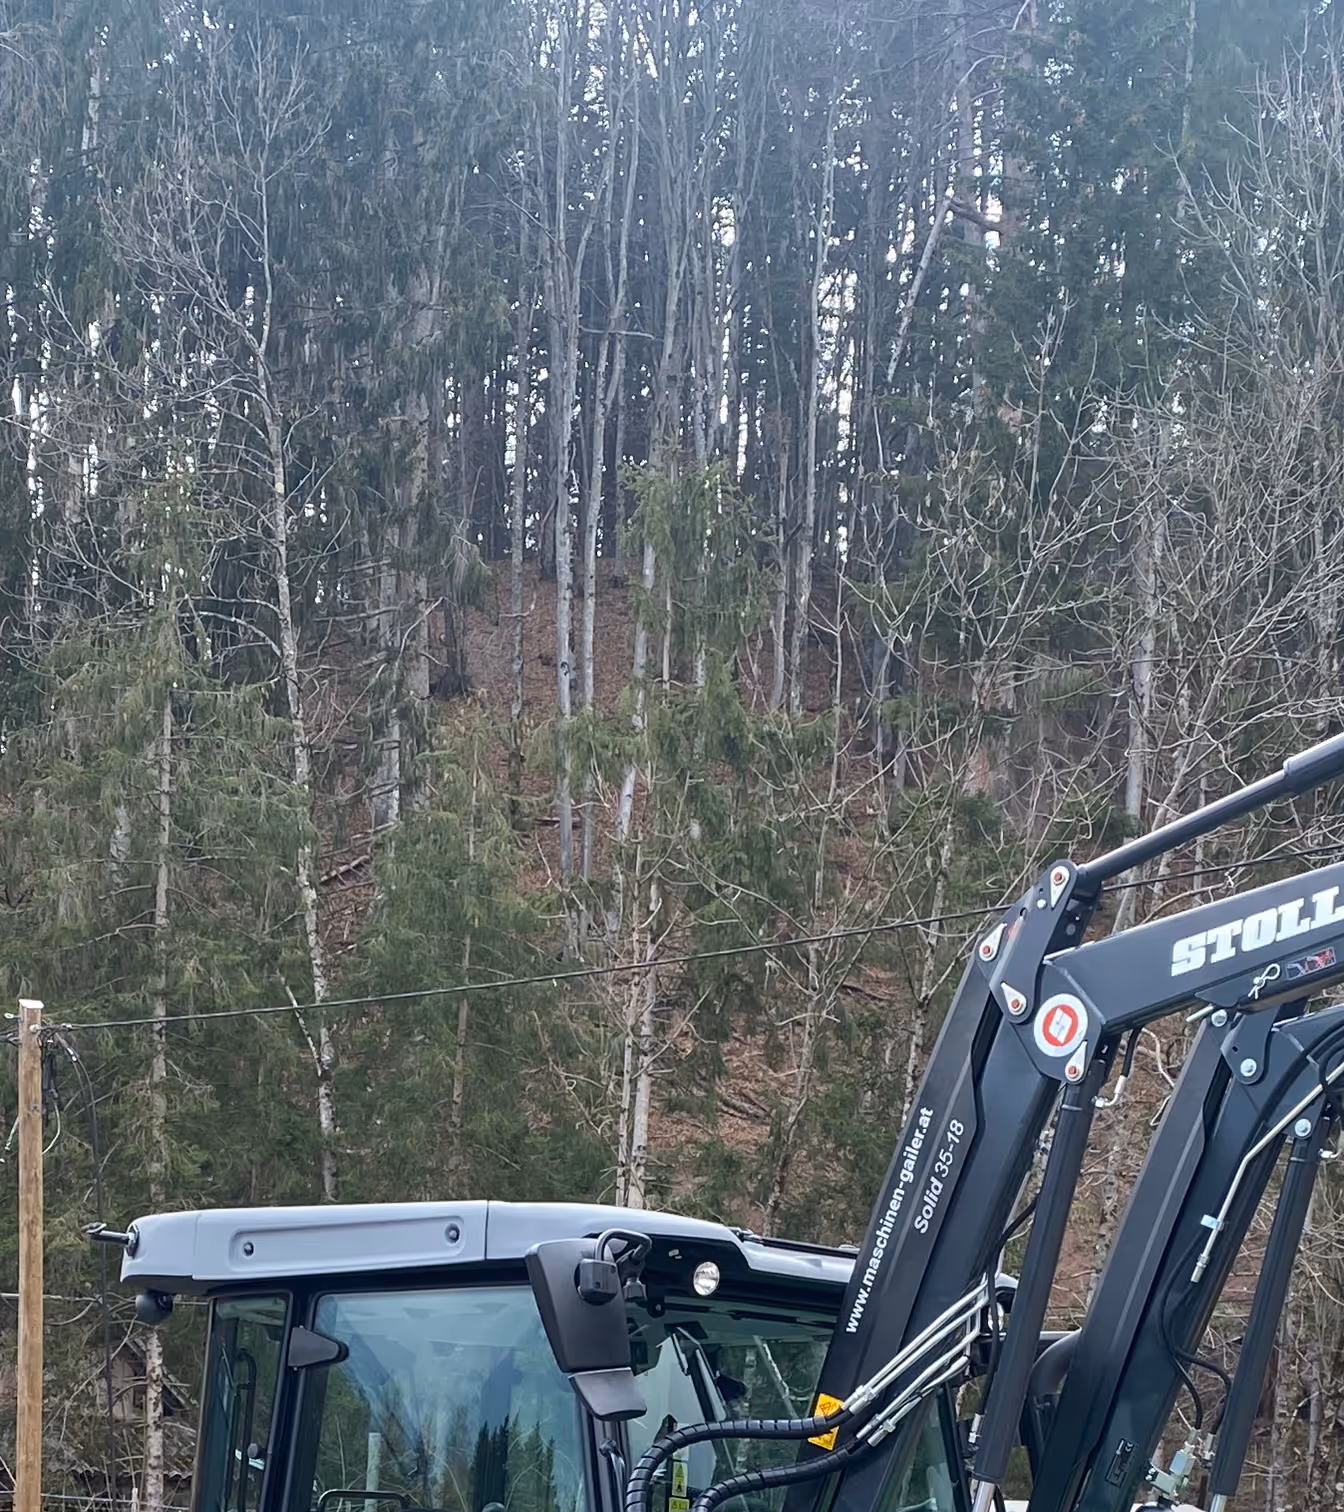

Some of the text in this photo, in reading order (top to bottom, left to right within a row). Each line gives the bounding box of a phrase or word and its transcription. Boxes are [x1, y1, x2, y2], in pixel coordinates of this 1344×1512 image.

[846, 1107, 934, 1333] www.maschinen-gailer.at
[914, 1119, 964, 1234] Solid 35-18
